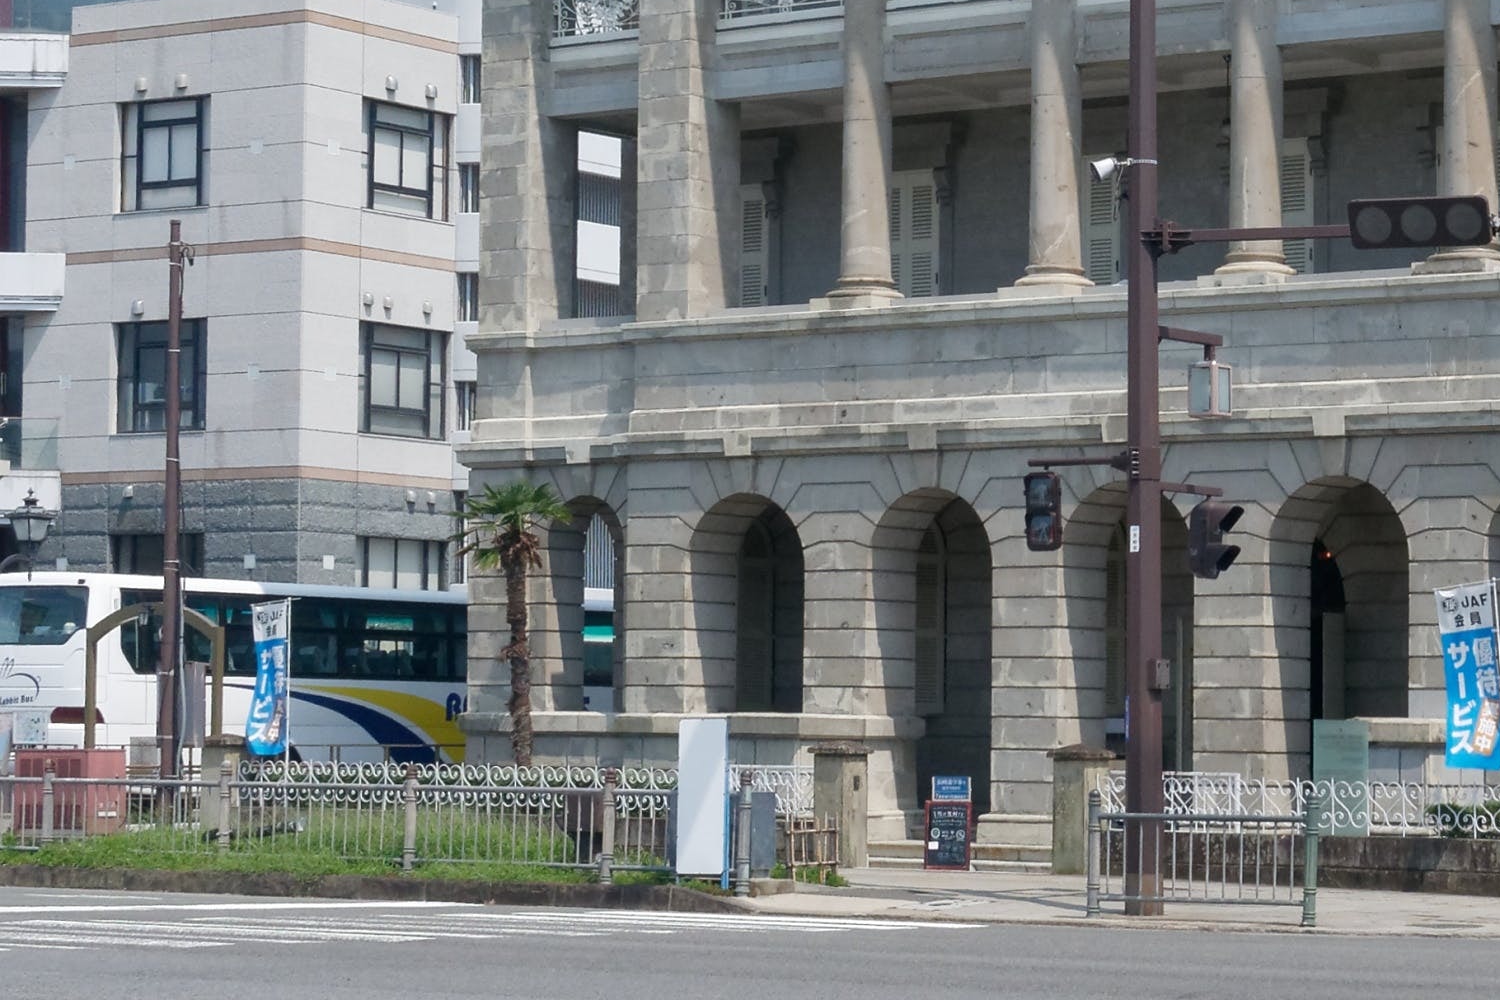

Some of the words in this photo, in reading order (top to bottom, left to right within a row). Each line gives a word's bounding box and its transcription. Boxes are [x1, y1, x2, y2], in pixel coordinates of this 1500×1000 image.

[1454, 611, 1482, 628] 会員
[1461, 593, 1488, 608] JAF
[248, 649, 273, 742] サービス
[1447, 641, 1477, 755] サービス
[1473, 636, 1498, 698] 優待
